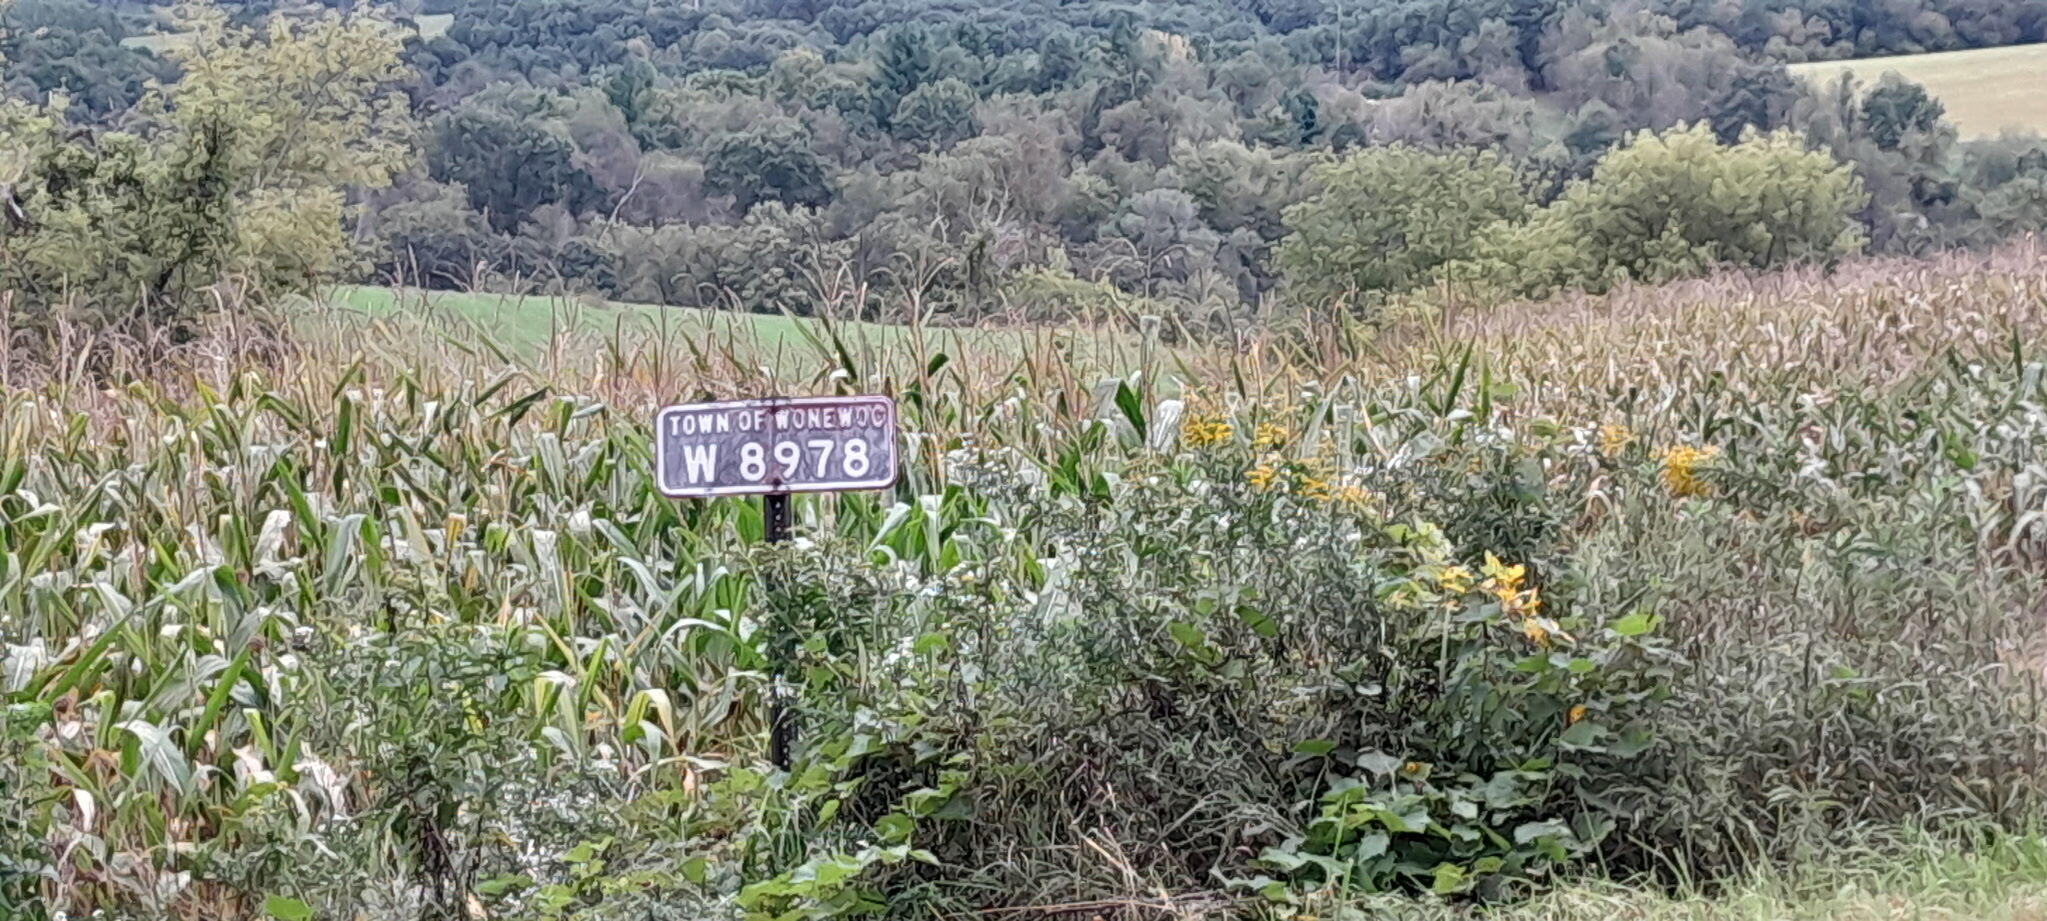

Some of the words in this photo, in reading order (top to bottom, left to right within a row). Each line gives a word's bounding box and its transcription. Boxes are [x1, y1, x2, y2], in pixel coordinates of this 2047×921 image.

[669, 414, 729, 436] TOWN
[738, 410, 767, 432] OF
[683, 443, 717, 484] W
[739, 438, 870, 482] 8978
